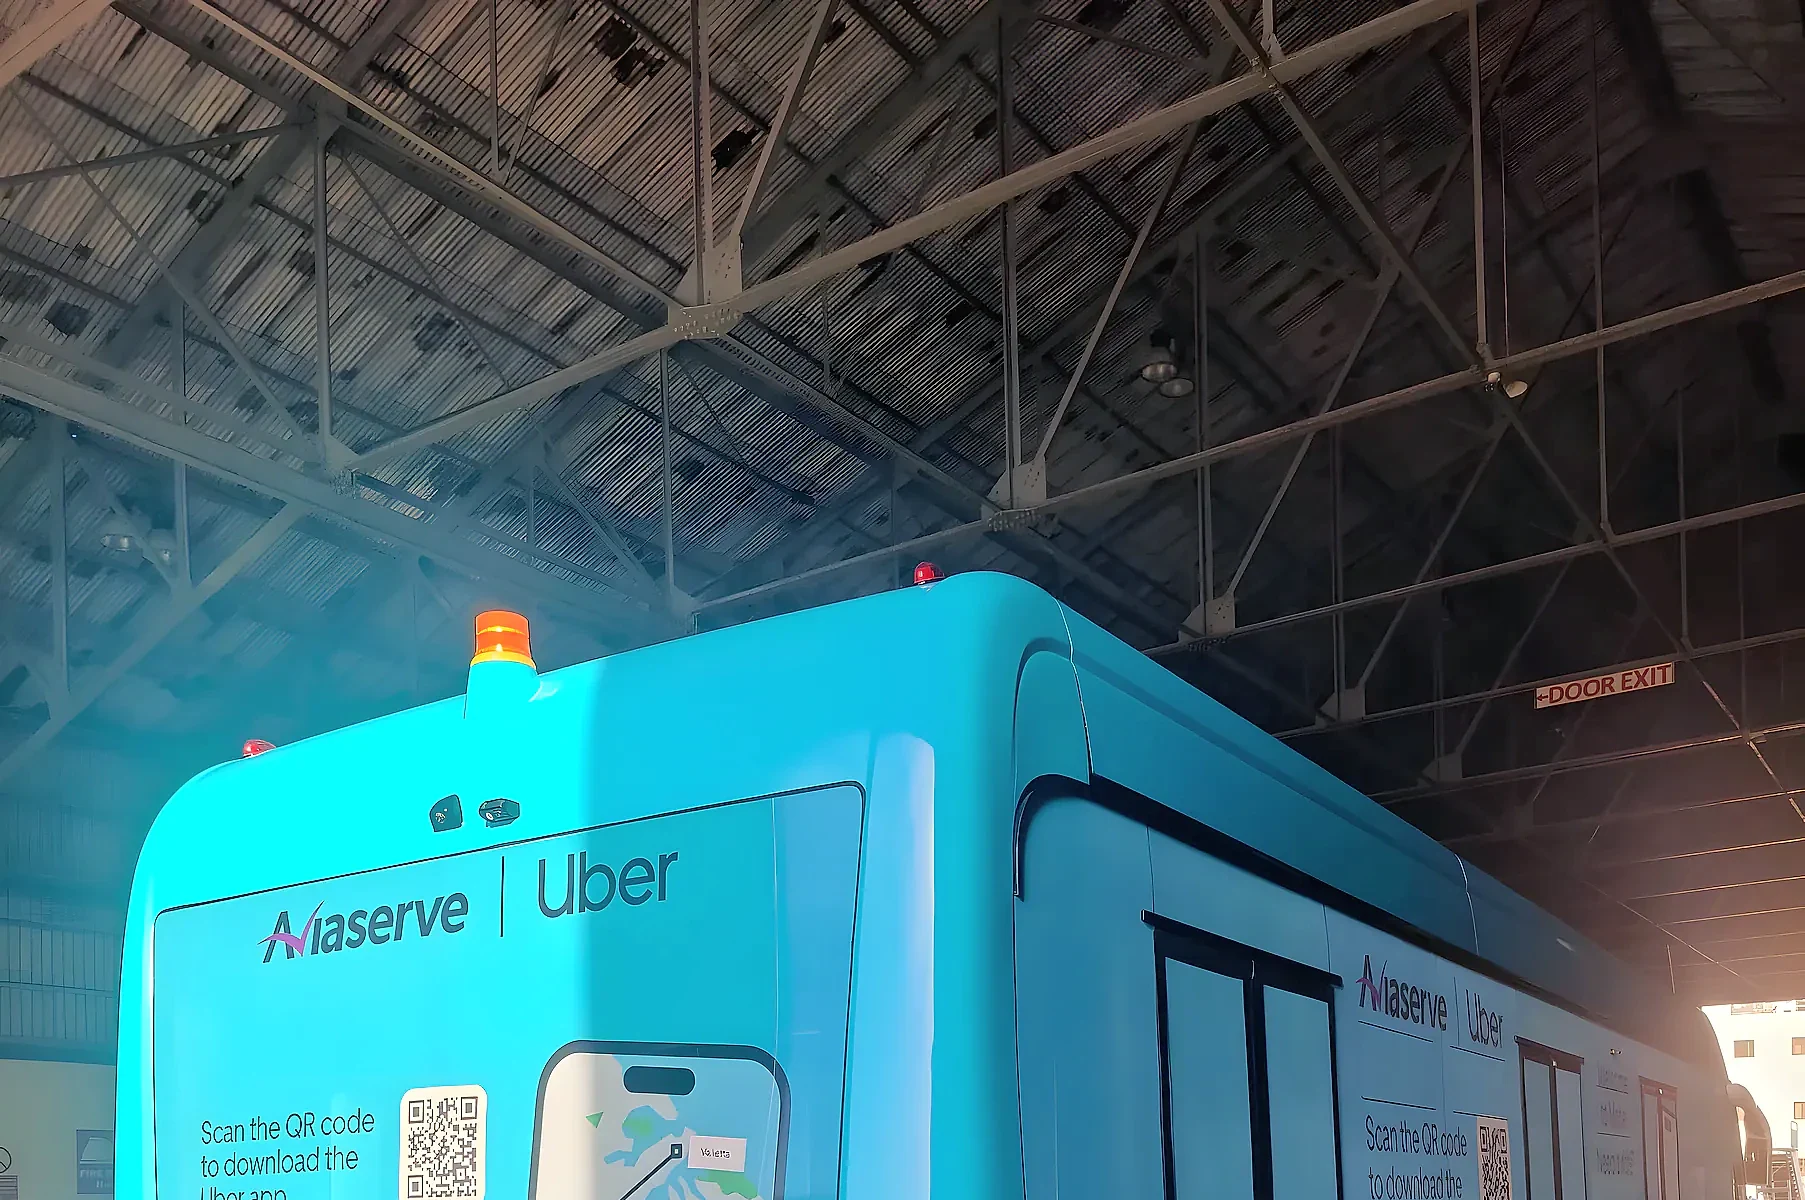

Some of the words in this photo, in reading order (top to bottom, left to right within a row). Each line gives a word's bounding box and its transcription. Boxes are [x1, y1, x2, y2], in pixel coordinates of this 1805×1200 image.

[1549, 676, 1615, 704] DOOR
[1621, 664, 1671, 691] EXIT
[257, 891, 469, 963] Aviaserve
[538, 851, 679, 918] Uber
[1466, 989, 1503, 1048] Uber
[201, 1120, 245, 1145] Scan
[250, 1116, 281, 1141] the
[286, 1112, 316, 1138] QR
[321, 1108, 375, 1136] code
[1365, 1114, 1398, 1152] Scan
[1400, 1120, 1420, 1153] the
[1421, 1122, 1440, 1156] QR
[1441, 1126, 1468, 1157] code
[201, 1156, 219, 1178] to
[224, 1146, 320, 1177] download
[325, 1145, 359, 1171] the
[1368, 1166, 1384, 1200] to
[1386, 1166, 1444, 1200] download
[1445, 1169, 1463, 1199] the
